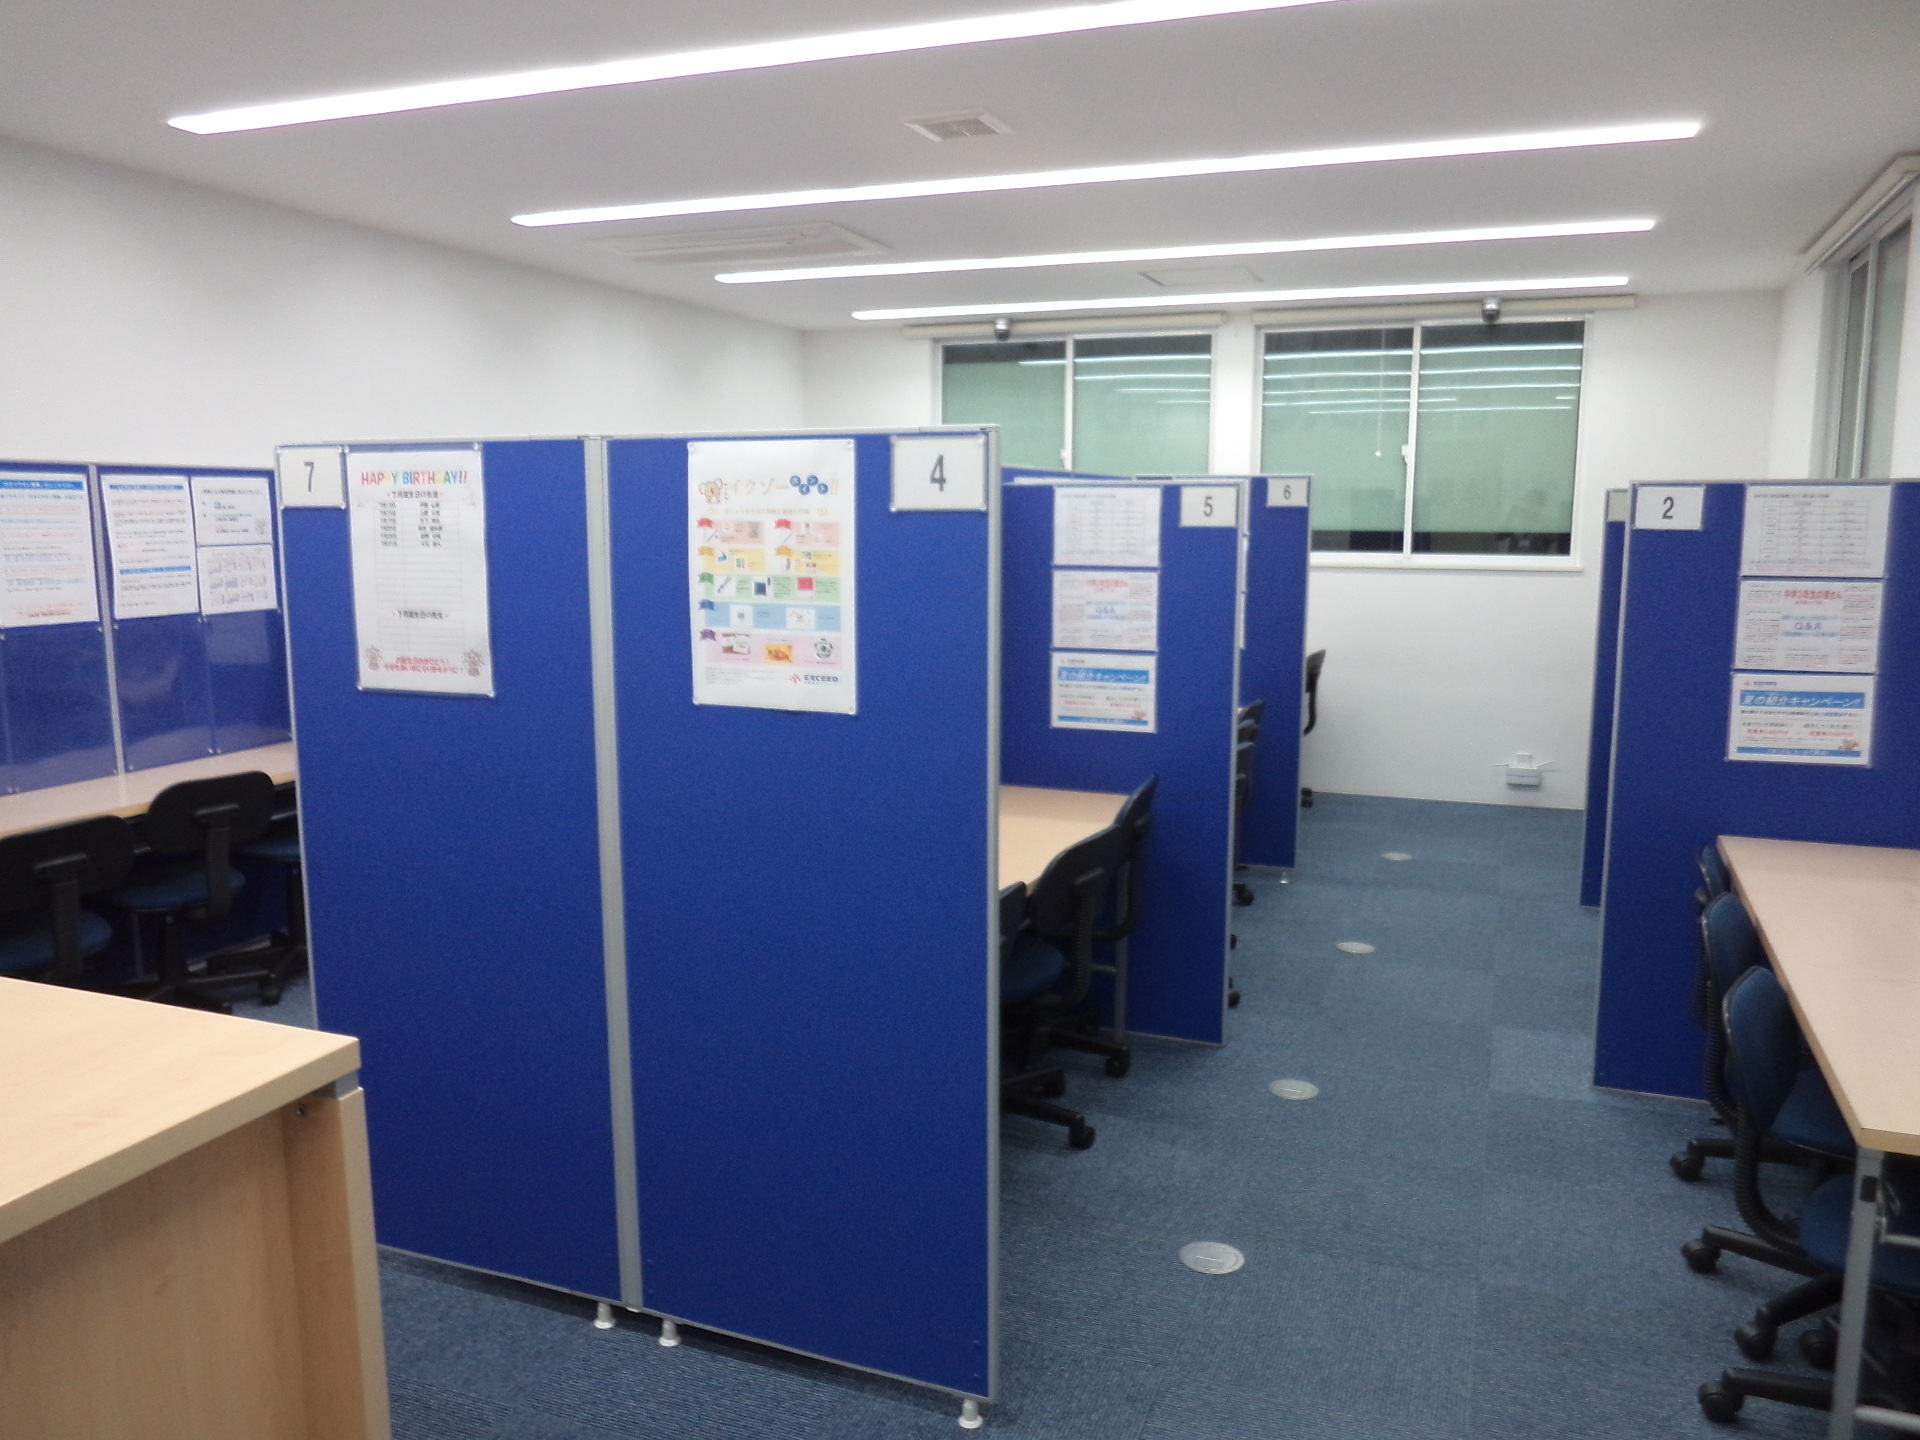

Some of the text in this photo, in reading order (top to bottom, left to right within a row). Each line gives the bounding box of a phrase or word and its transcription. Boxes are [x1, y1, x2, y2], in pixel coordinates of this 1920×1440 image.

[303, 461, 315, 493] 7
[361, 470, 468, 485] HAPY BIRTHAY!!
[928, 454, 947, 492] 4
[1283, 485, 1292, 499] 6
[1203, 496, 1213, 517] 5
[1661, 496, 1675, 519] 2
[803, 674, 839, 683] EXCEED
